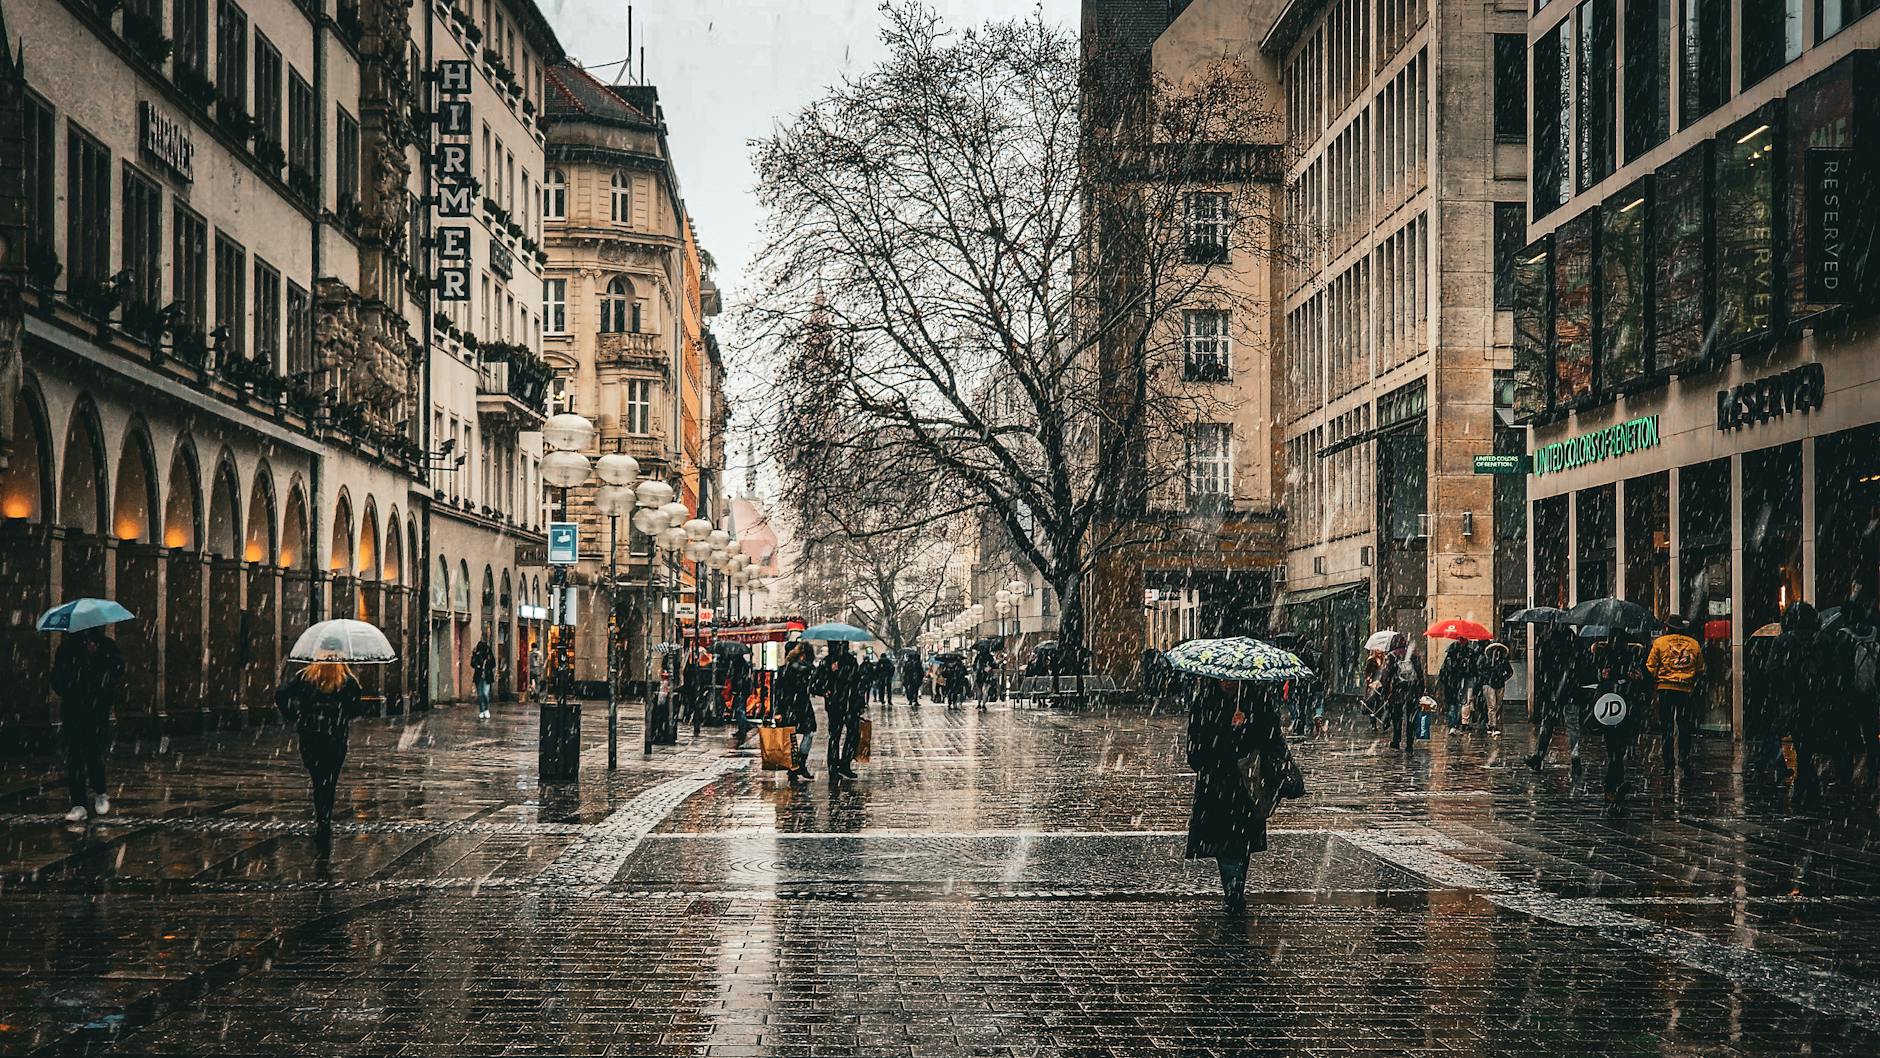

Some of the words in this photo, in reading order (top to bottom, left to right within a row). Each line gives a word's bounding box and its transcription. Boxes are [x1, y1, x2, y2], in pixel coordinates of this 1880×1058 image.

[146, 102, 194, 181] HIRMER
[439, 63, 470, 297] HIRMER
[1823, 160, 1839, 290] RESERVED
[1535, 442, 1565, 476] UNITED
[1565, 432, 1599, 469] COLORS
[1598, 428, 1613, 460] OF
[1600, 701, 1622, 719] JD
